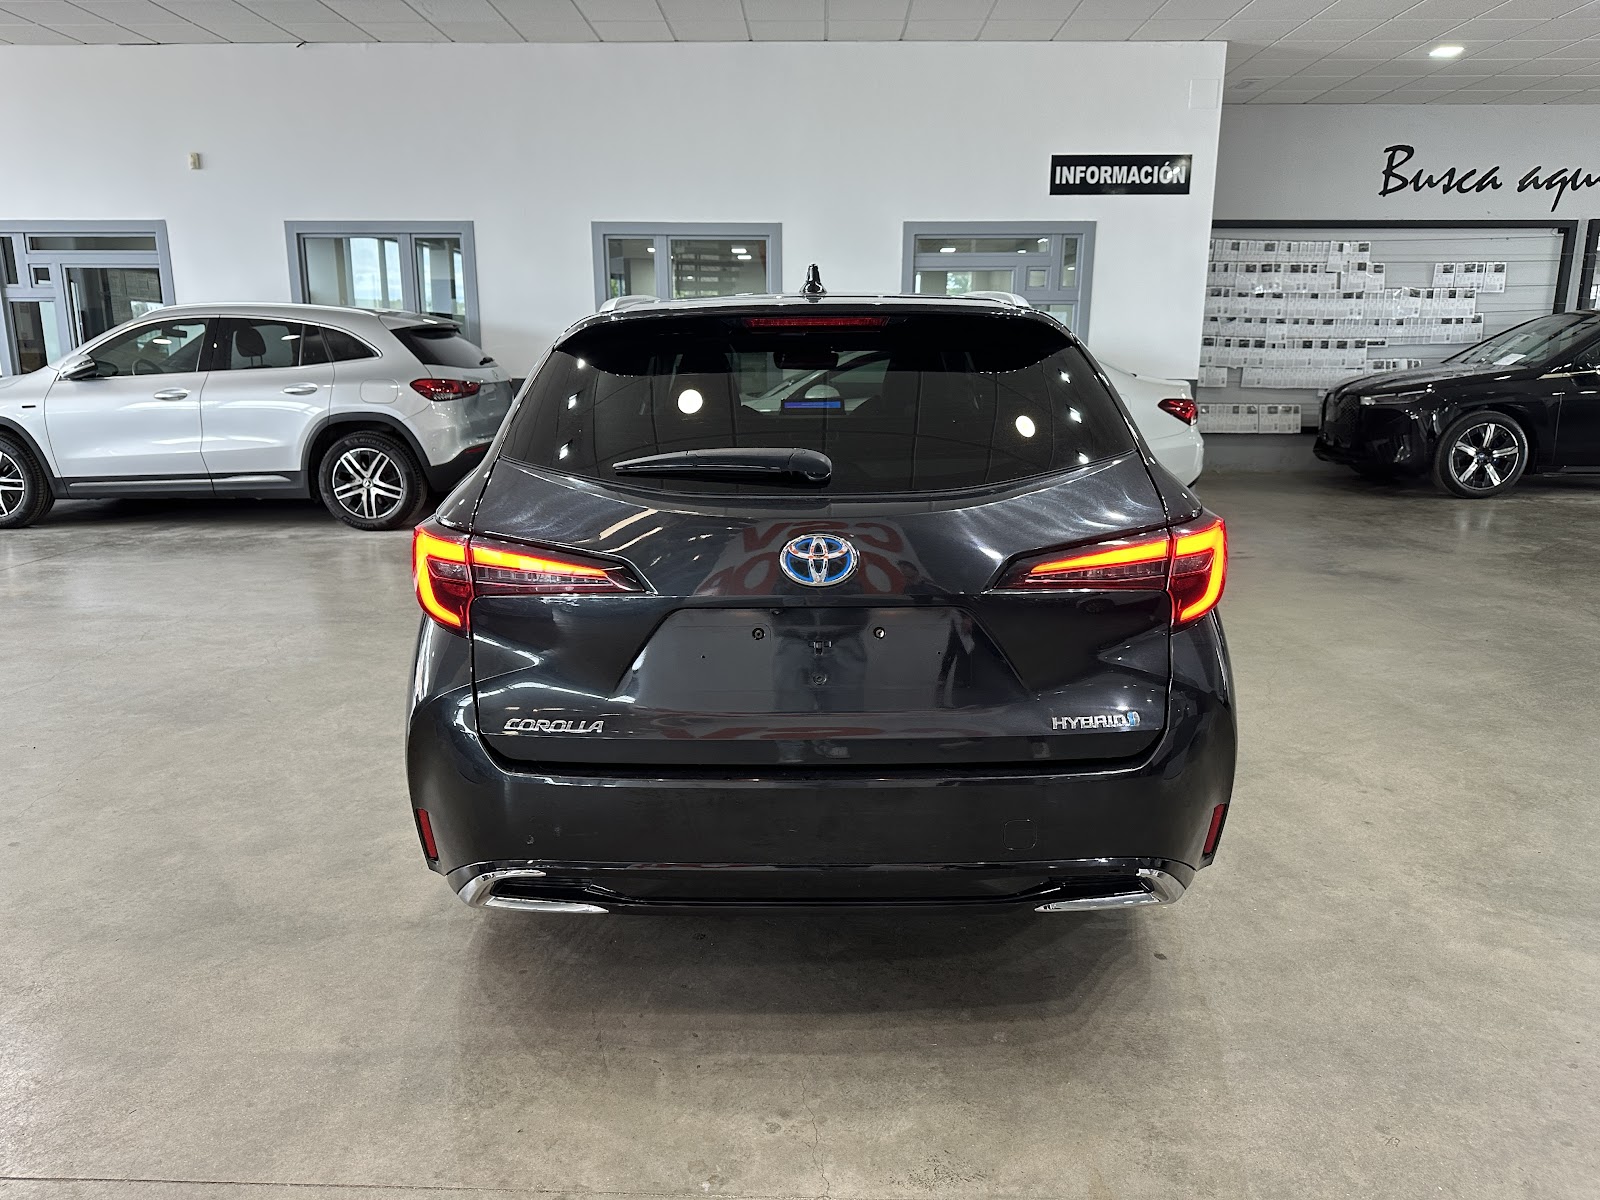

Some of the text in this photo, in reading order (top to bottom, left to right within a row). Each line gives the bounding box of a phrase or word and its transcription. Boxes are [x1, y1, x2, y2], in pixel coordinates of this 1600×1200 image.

[1054, 161, 1187, 185] INFORMACIÓN
[1378, 144, 1600, 213] Busca aqu
[503, 718, 605, 734] COROLLA
[1051, 714, 1130, 730] HYBRID
